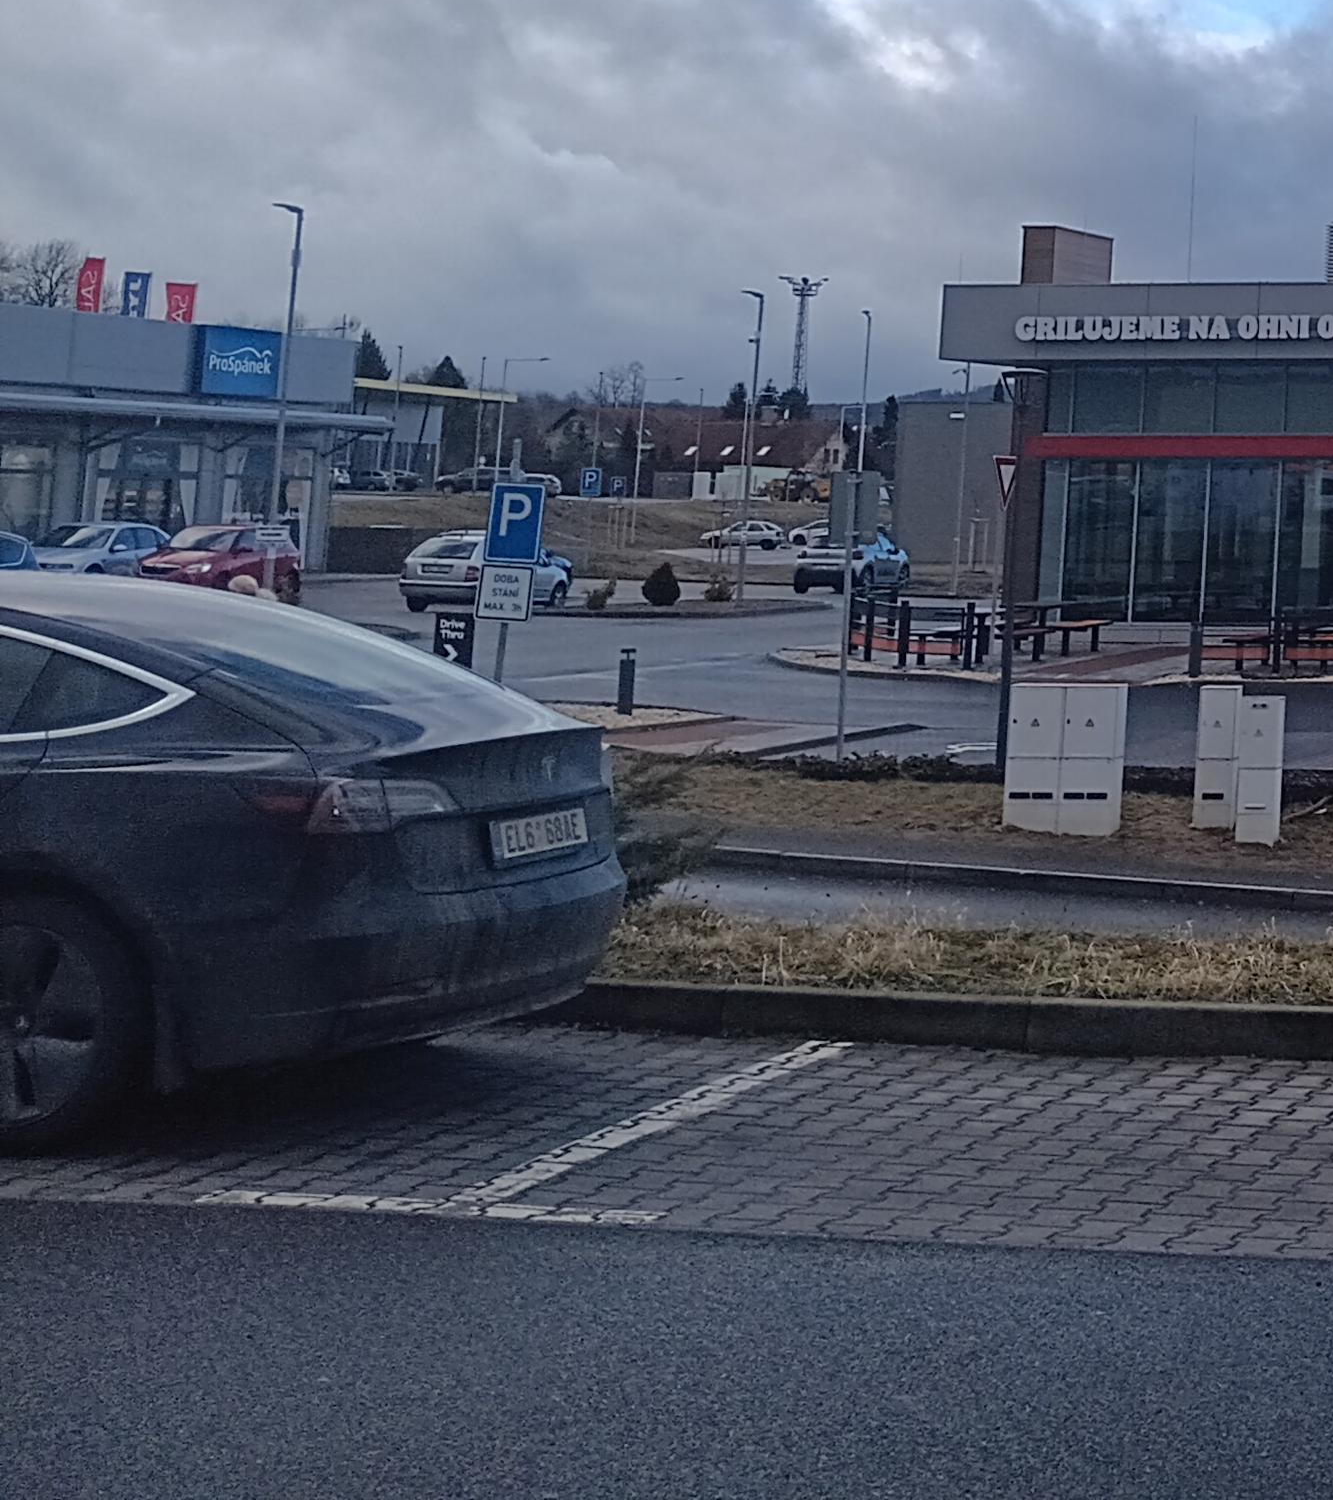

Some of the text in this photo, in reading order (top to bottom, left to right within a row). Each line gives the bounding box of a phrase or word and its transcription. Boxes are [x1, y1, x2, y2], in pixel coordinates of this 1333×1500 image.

[1015, 315, 1180, 341] GRILUJEME
[1188, 315, 1230, 340] NA
[1237, 315, 1310, 340] OHNI
[208, 353, 272, 377] ProSpánek
[585, 471, 597, 488] P
[498, 492, 532, 536] P
[493, 573, 520, 583] DOBA
[439, 618, 466, 630] Drive
[439, 629, 464, 640] Thru
